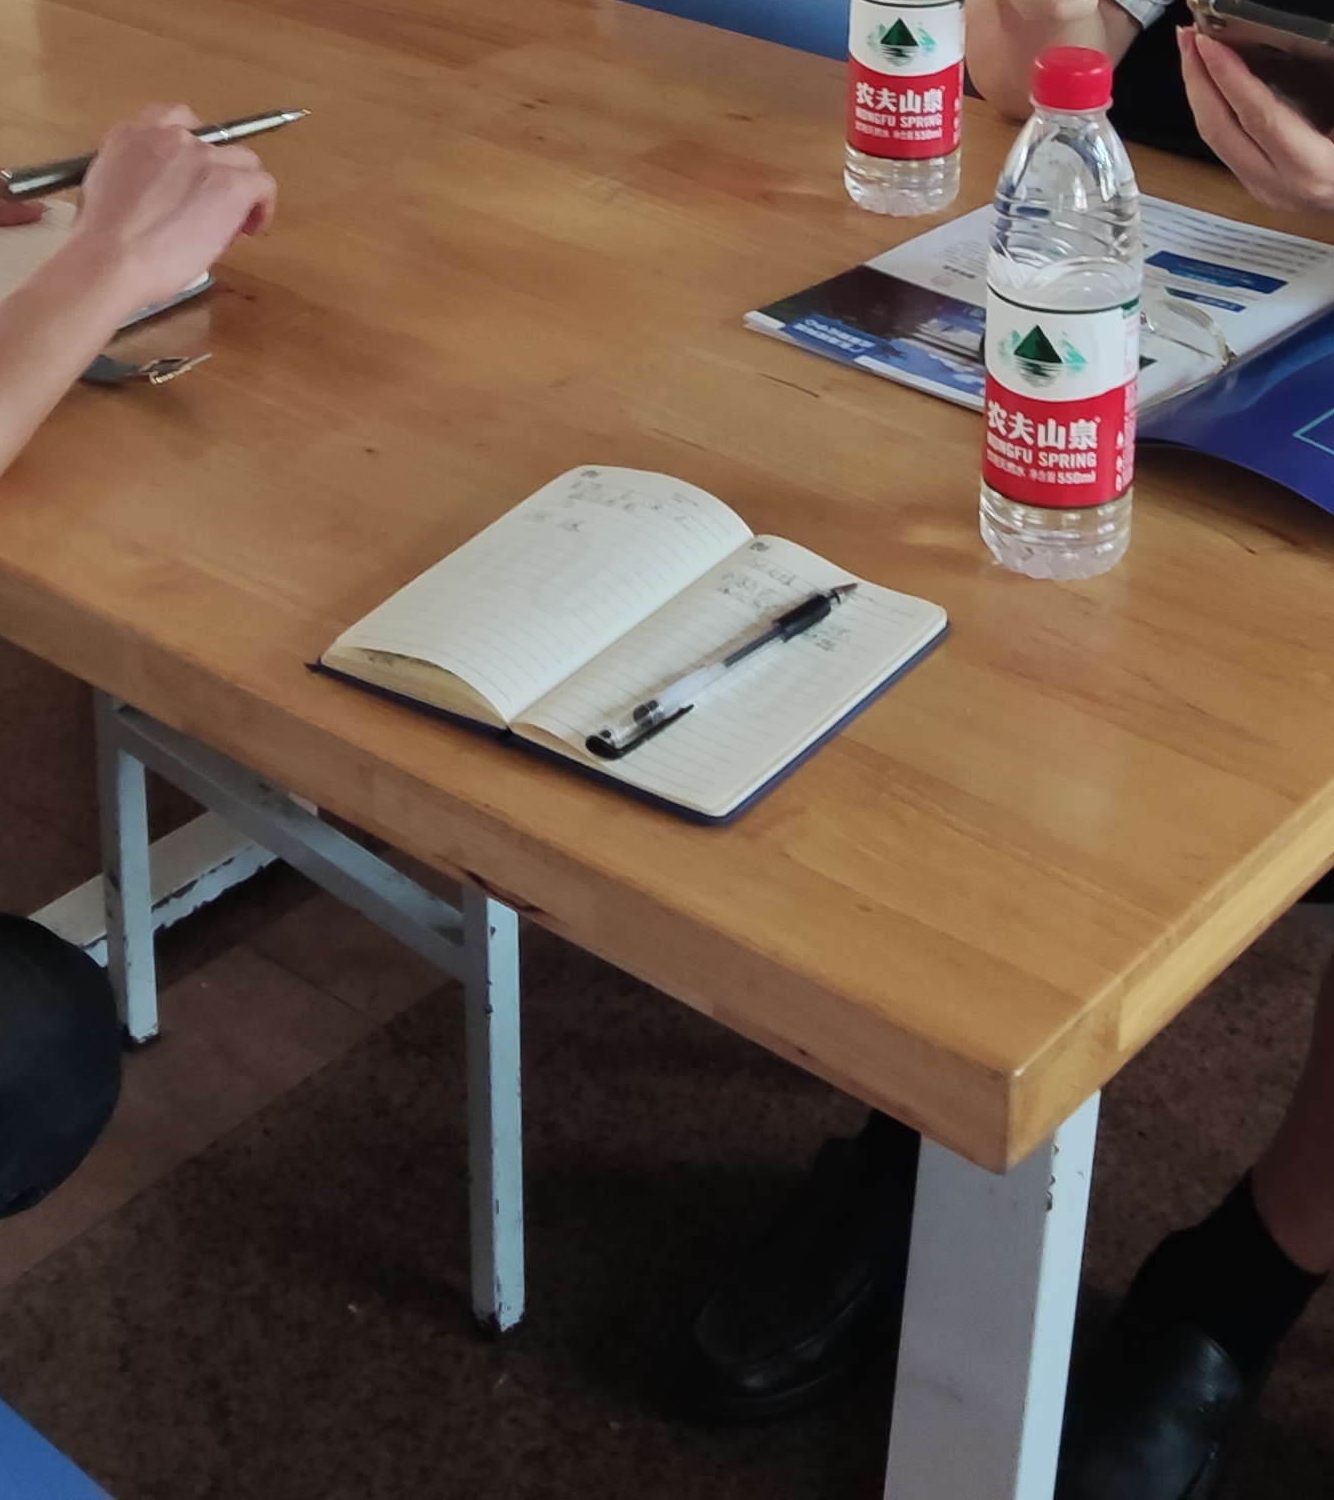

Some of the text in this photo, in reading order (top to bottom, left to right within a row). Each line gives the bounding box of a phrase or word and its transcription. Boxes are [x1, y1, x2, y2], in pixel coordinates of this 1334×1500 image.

[855, 81, 944, 114] 农夫山泉
[899, 113, 943, 129] SPRING
[986, 399, 1098, 451] 农夫山泉
[1037, 450, 1098, 470] SPRING
